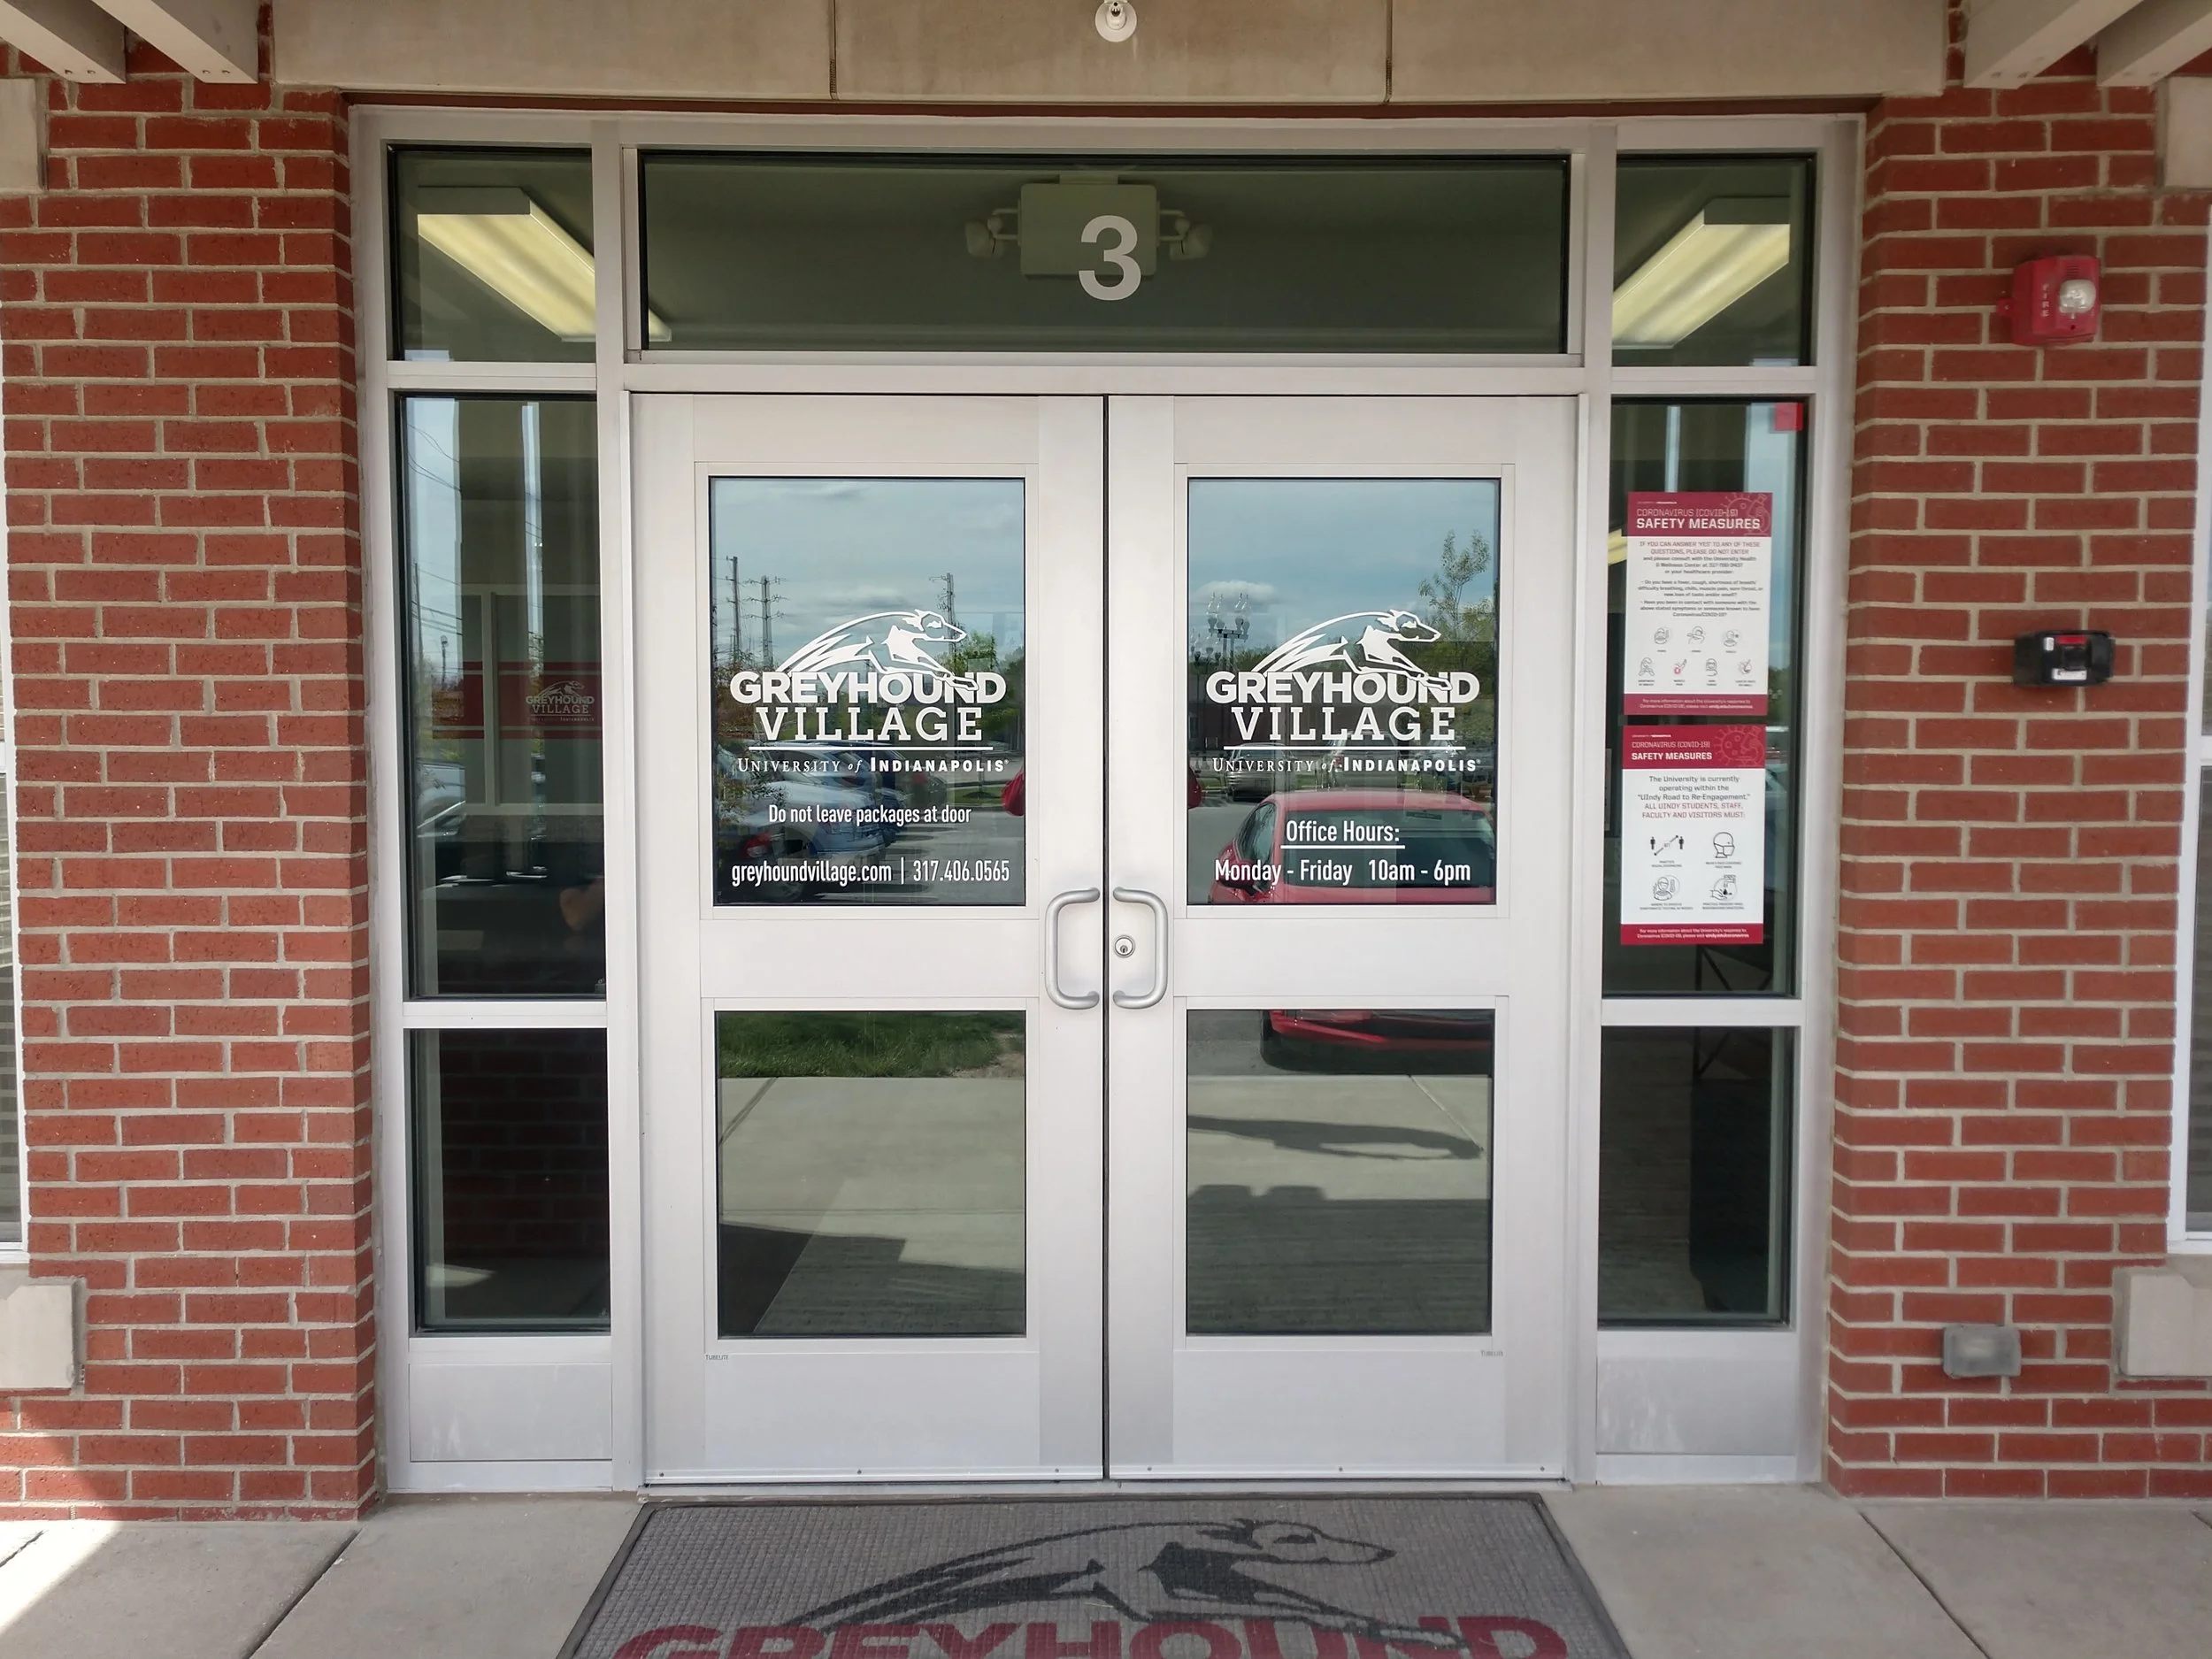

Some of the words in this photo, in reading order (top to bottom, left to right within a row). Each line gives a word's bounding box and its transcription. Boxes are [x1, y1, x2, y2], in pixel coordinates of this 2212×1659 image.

[1078, 214, 1141, 301] 3
[1637, 518, 1686, 529] SAFETY
[1688, 518, 1761, 529] MEASURES
[526, 695, 595, 704] GREYHOUND
[730, 672, 1007, 703] GREYHOUND
[1206, 671, 1480, 703] GREYHOUND
[532, 704, 589, 713] VILLAGE
[757, 707, 982, 741] VILLAGE
[1231, 706, 1455, 741] VILLAGE
[737, 757, 840, 772] UNIVERSITY
[848, 758, 863, 773] of
[1212, 757, 1314, 772] UNIVERSITY
[1321, 758, 1336, 773] of
[769, 804, 787, 822] Do
[790, 806, 813, 822] not
[816, 804, 852, 822] leave
[856, 805, 920, 827] packages
[924, 807, 939, 822] at
[941, 804, 972, 822] door
[1286, 820, 1337, 841] Office
[1343, 820, 1401, 841] Hours:
[732, 860, 892, 887] greyhoundvillage.com
[913, 860, 1010, 881] 317.406.0565
[1215, 859, 1282, 886] Monday
[1300, 859, 1353, 886] Friday
[1369, 859, 1415, 881] 10am
[1433, 859, 1471, 886] 6pm
